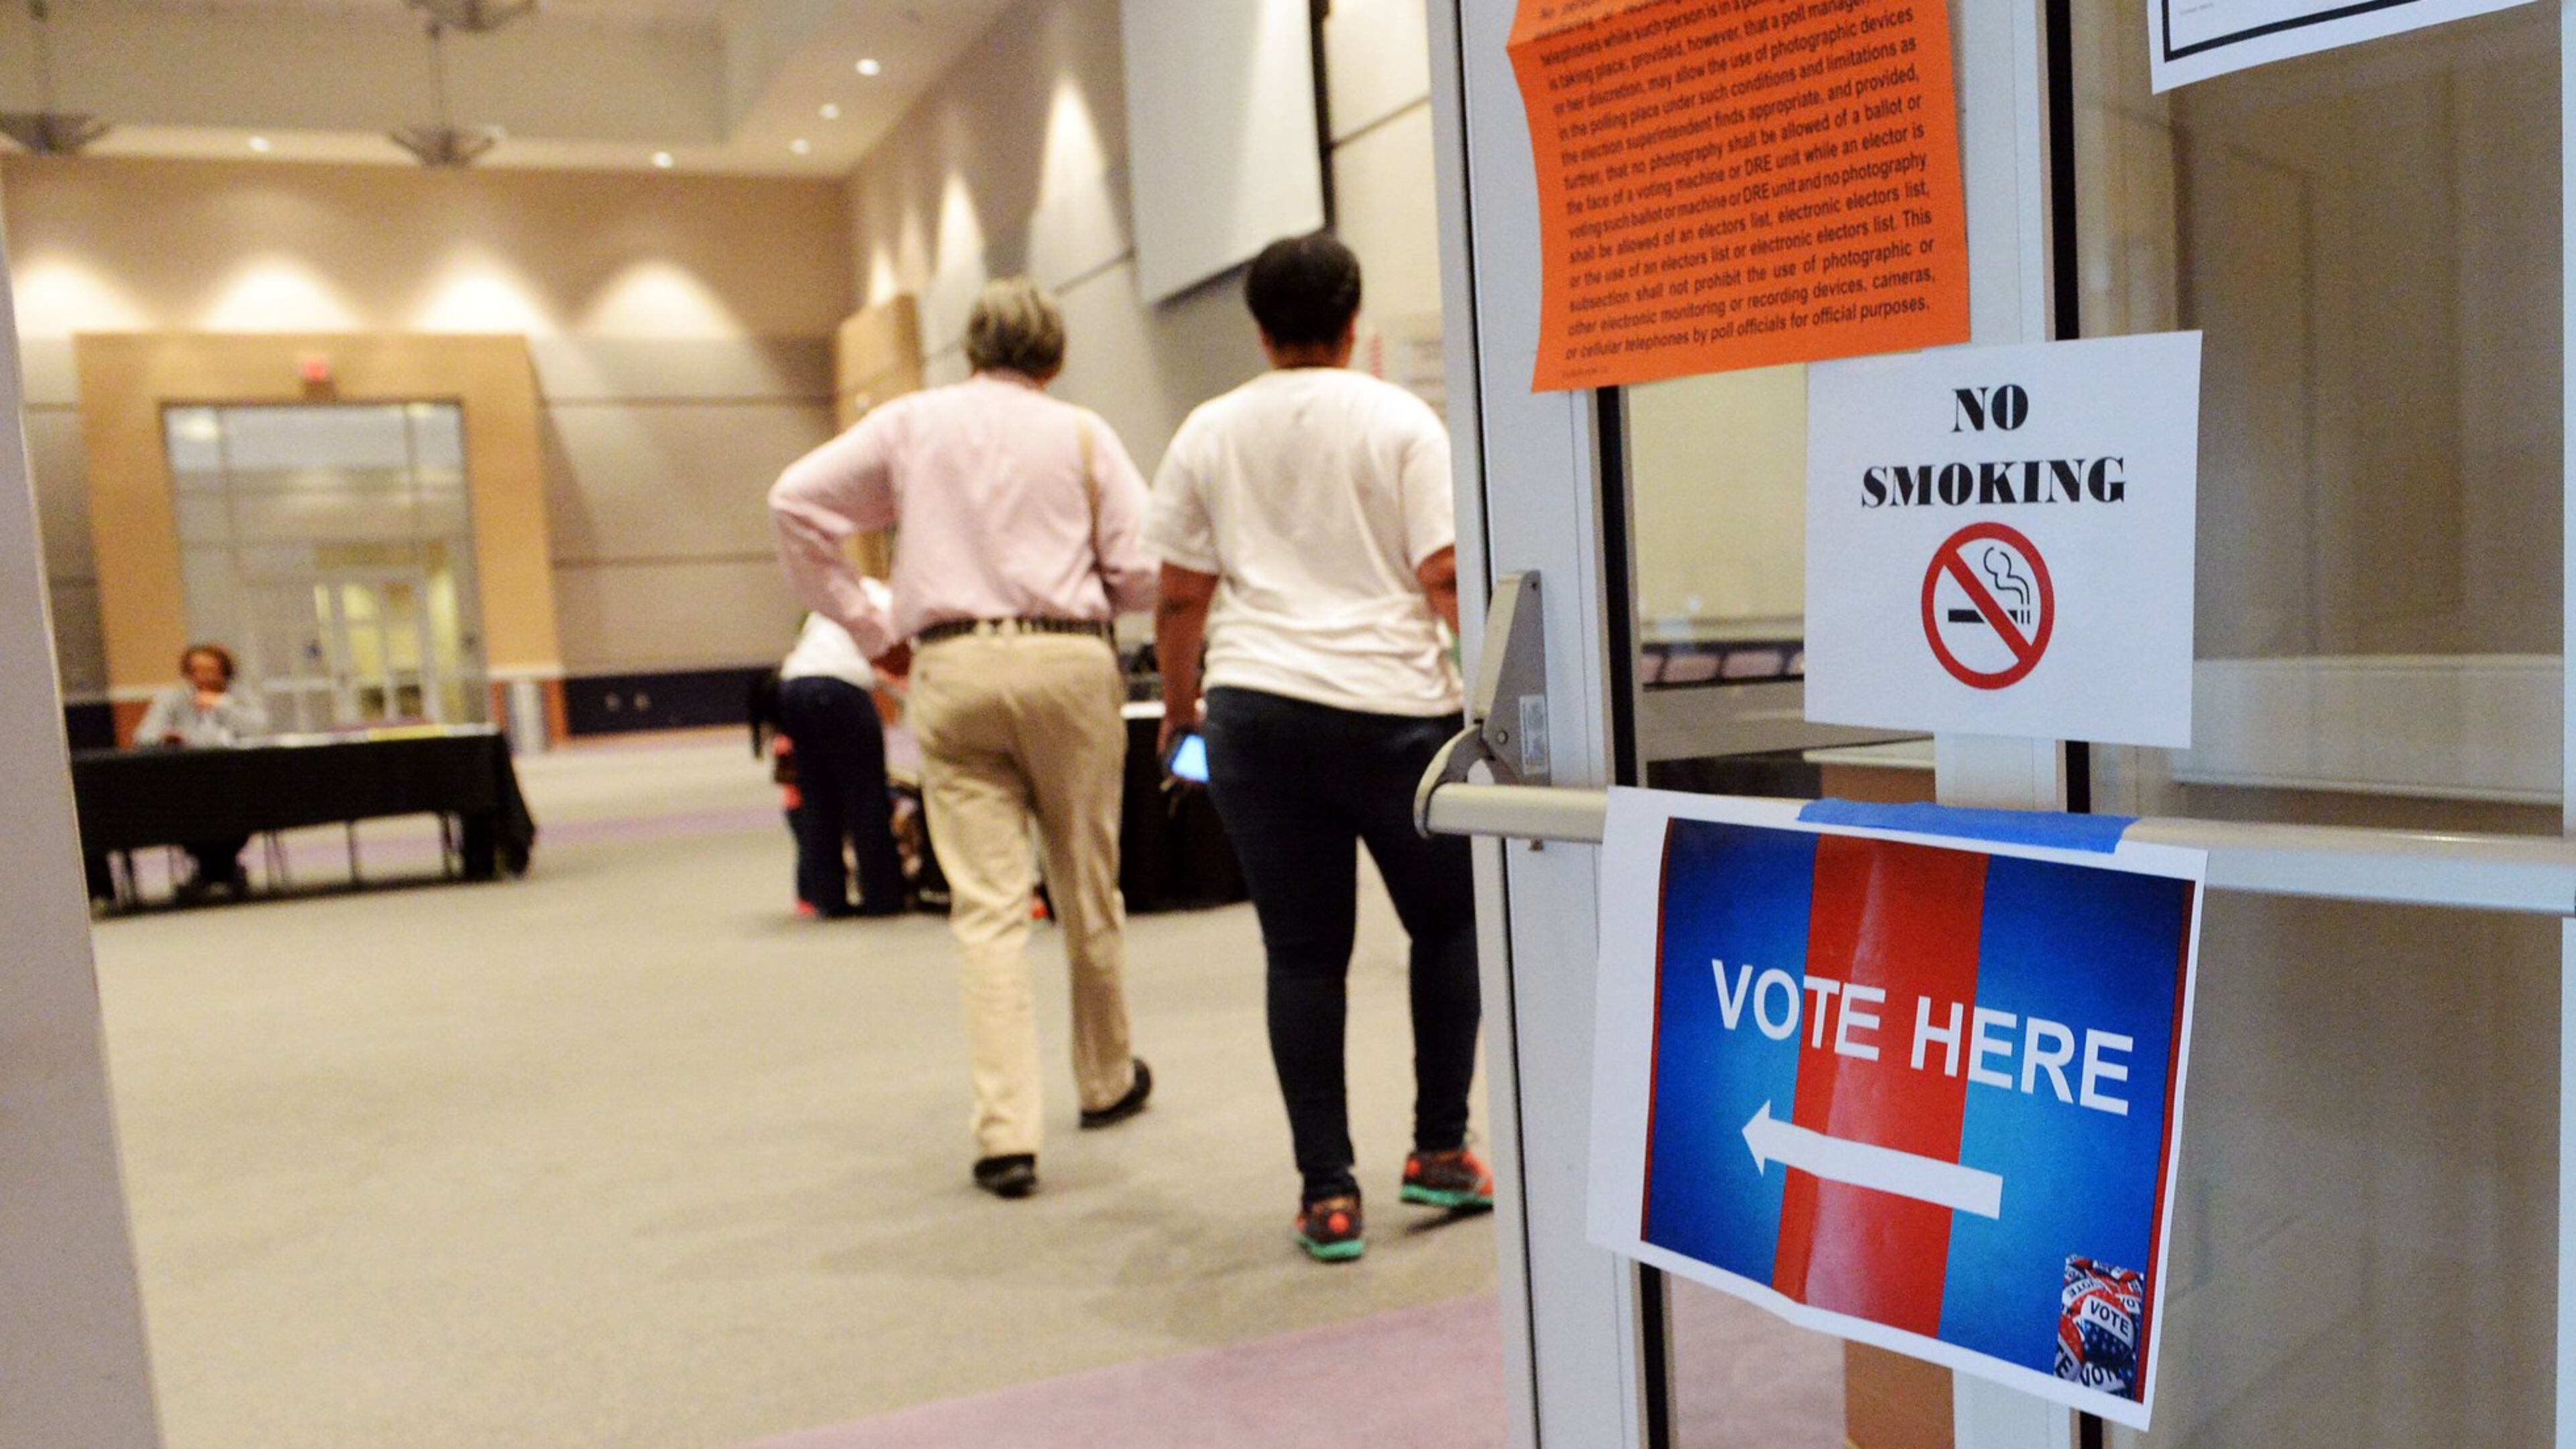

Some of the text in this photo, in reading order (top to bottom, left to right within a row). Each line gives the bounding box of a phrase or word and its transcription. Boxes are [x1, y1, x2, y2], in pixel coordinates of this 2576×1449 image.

[1561, 149, 1577, 165] the
[1581, 140, 1623, 160] election
[1626, 115, 1711, 150] superintendent
[1715, 108, 1744, 128] finds
[1827, 80, 1852, 101] and
[1606, 162, 1627, 180] that
[1631, 161, 1645, 174] no
[1650, 140, 1723, 174] photography
[1727, 131, 1756, 152] shall
[1760, 128, 1776, 144] be
[1781, 113, 1829, 140] allowed
[1834, 109, 1847, 127] of
[1851, 110, 1860, 123] a
[1864, 97, 1902, 121] ballot
[1907, 96, 1921, 111] or
[1566, 123, 1924, 214] the face of a voting machine or DRE unit while an elector is
[1569, 151, 1927, 238] voting such ballot or machine or DRE unit and no photography
[1569, 244, 1595, 263] shall
[1599, 242, 1612, 257] be
[1617, 231, 1660, 254] allowed
[1664, 228, 1675, 245] of
[1679, 229, 1693, 241] an
[1698, 218, 1746, 238] electors
[1778, 198, 1840, 223] electronic
[1845, 188, 1899, 210] electors
[1569, 276, 1580, 287] or
[1584, 269, 1601, 285] the
[1605, 267, 1624, 281] use
[1629, 261, 1640, 277] of
[1643, 261, 1657, 274] an
[1661, 252, 1707, 271] electors
[1711, 245, 1729, 262] list
[1733, 245, 1746, 258] or
[1750, 231, 1811, 255] electronic
[1817, 222, 1868, 243] electors
[1903, 208, 1932, 227] This
[1568, 319, 1596, 335] other
[1600, 309, 1656, 331] electronic
[1660, 300, 1725, 321] monitoring
[1729, 298, 1741, 311] or
[1747, 286, 1809, 308] recording
[1569, 239, 1933, 312] subsection shall not prohibit the use of photographic or
[1566, 347, 1576, 359] or
[1580, 339, 1621, 357] cellular
[1625, 331, 1688, 352] telephones
[1693, 325, 1707, 344] by
[1710, 321, 1734, 342] poll
[1737, 314, 1786, 335] officials
[1790, 312, 1807, 327] for
[1812, 303, 1857, 324] official
[1951, 384, 2029, 433] NO
[1862, 457, 2125, 508] SMOKING
[1711, 959, 2134, 1116] VOTE HERE
[2090, 1299, 2129, 1336] VOTE
